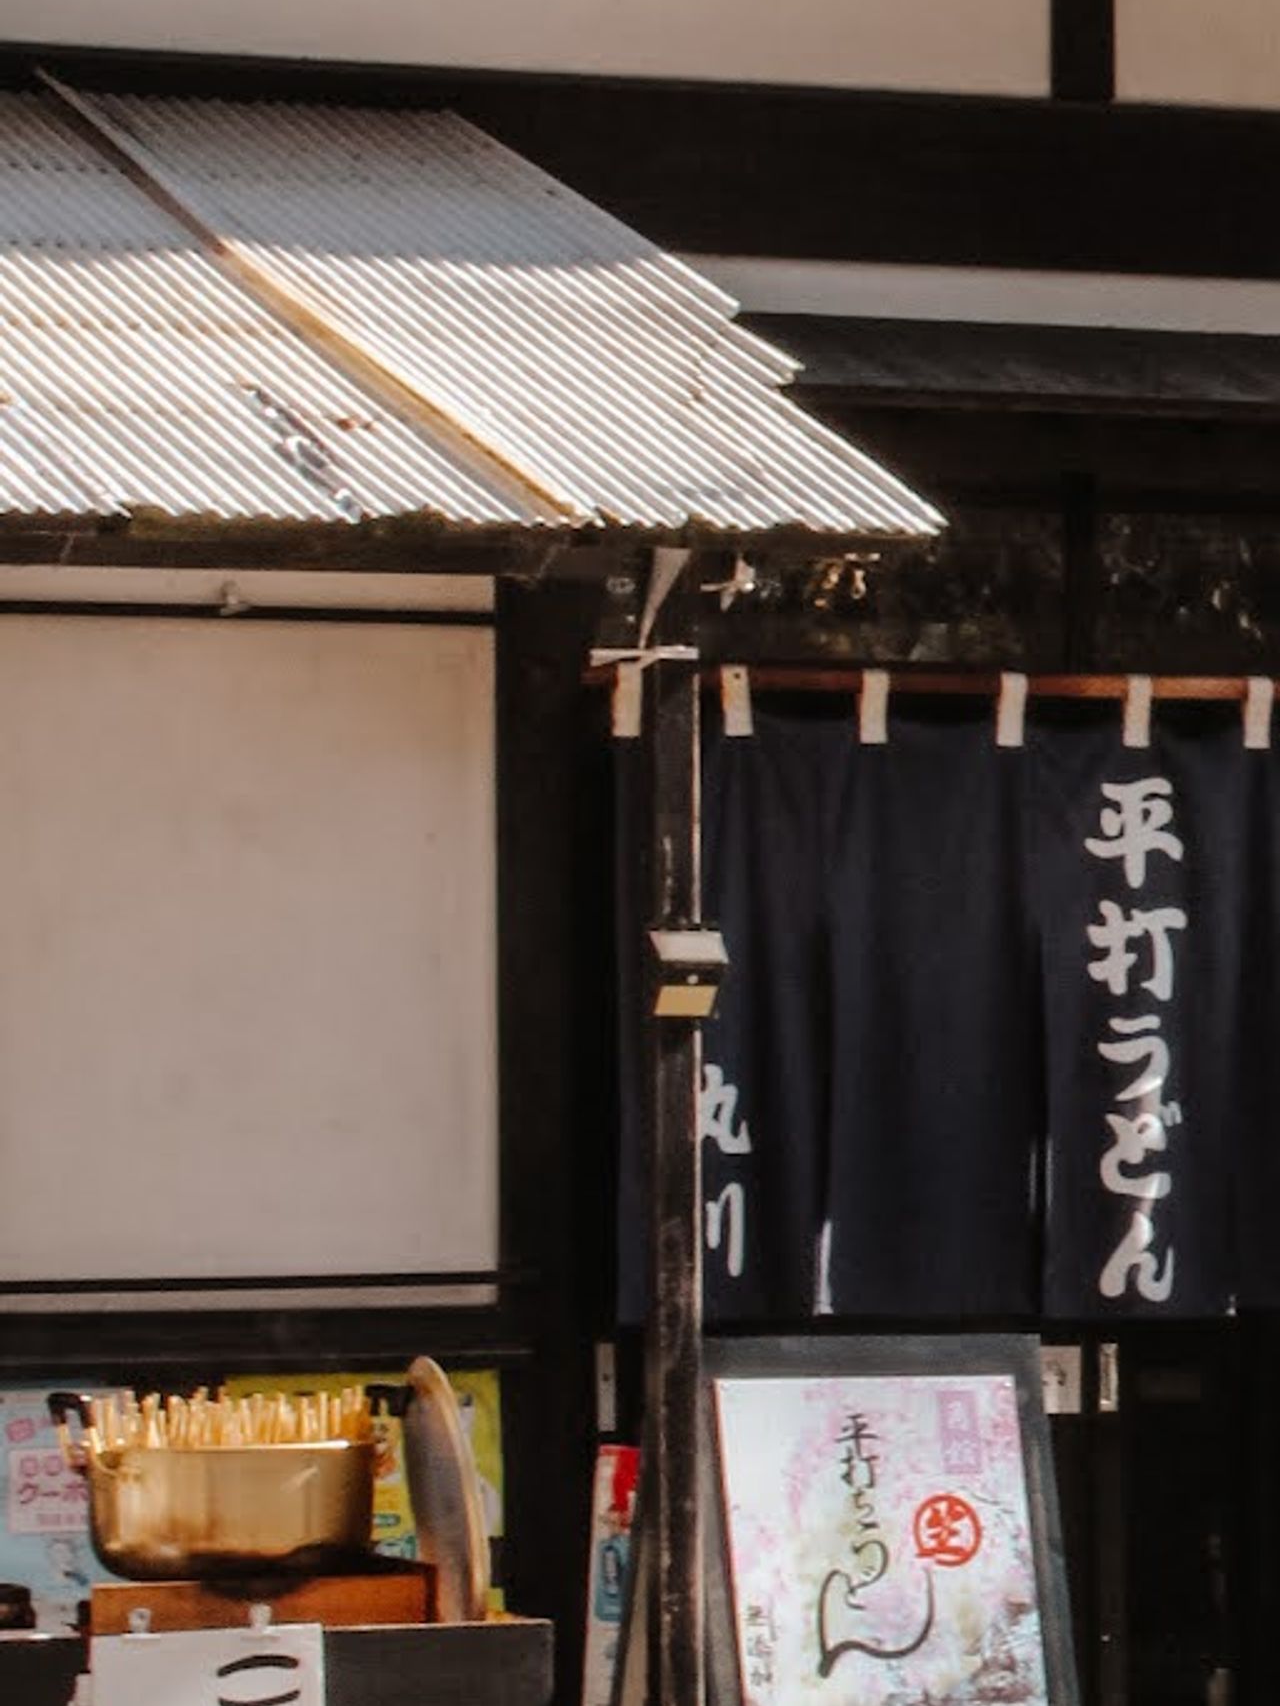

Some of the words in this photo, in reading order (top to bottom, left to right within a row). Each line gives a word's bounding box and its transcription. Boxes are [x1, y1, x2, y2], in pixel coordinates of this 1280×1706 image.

[1084, 776, 1188, 1302] 平打うどん
